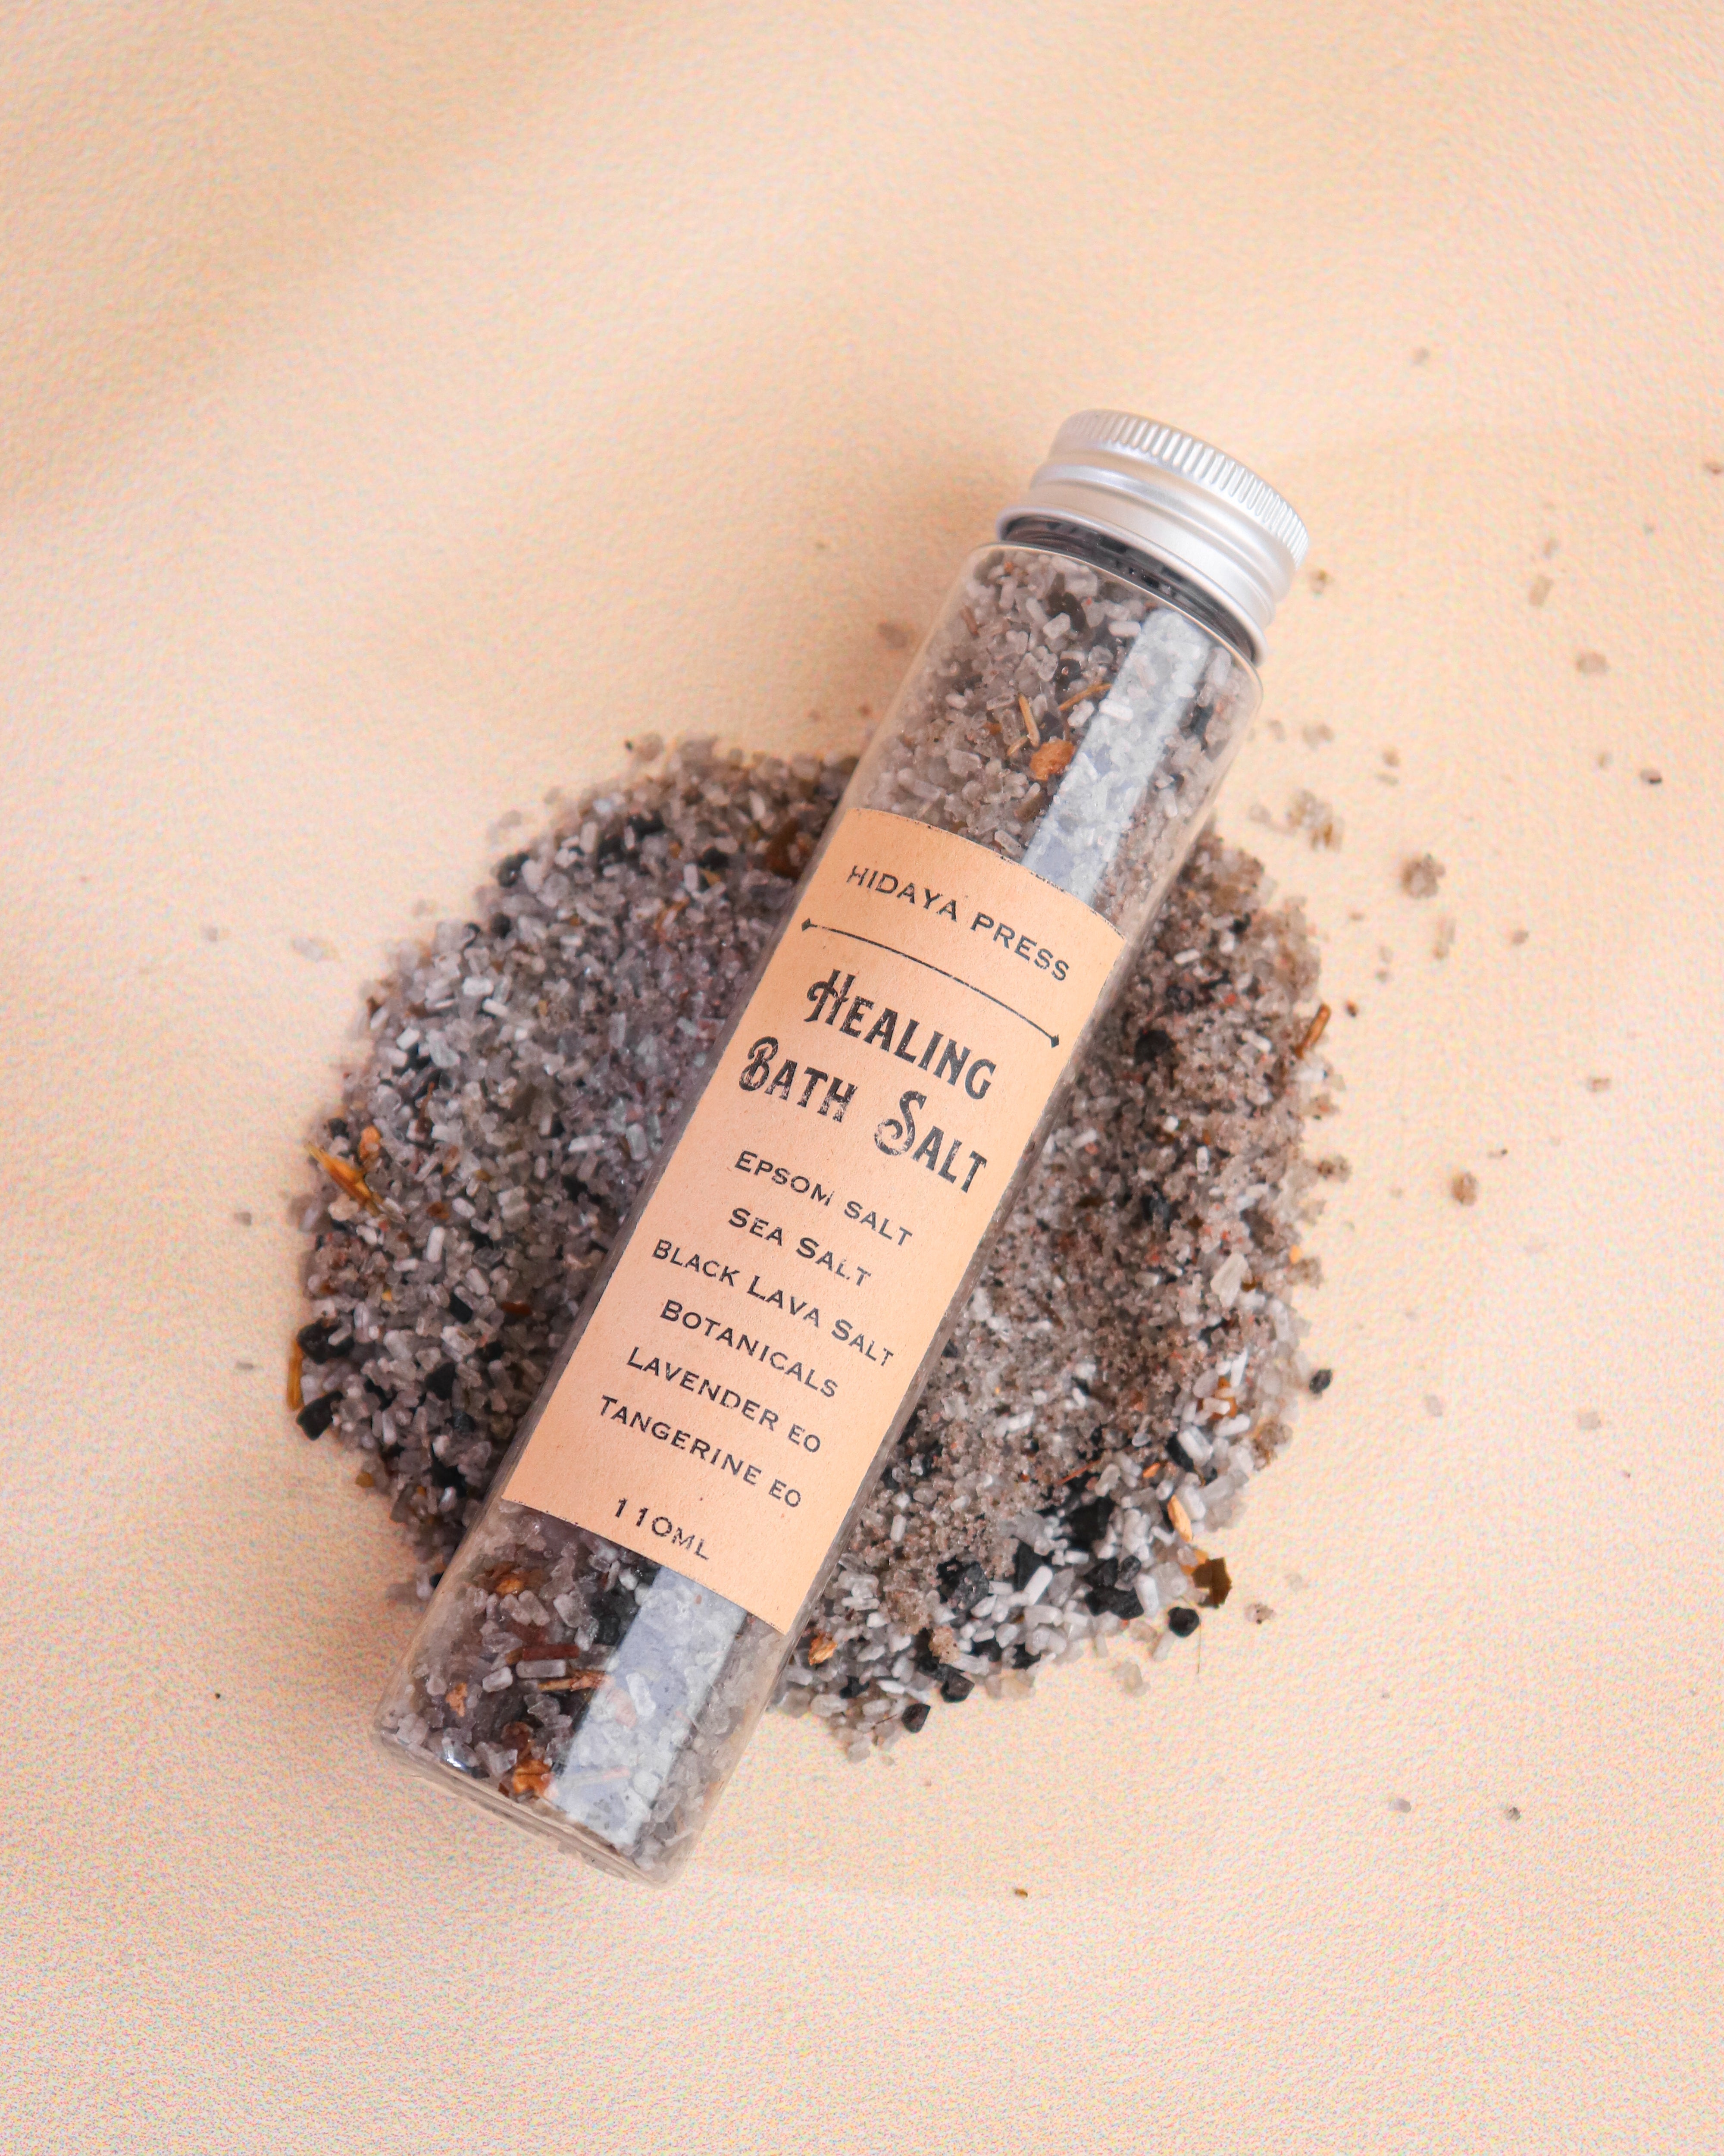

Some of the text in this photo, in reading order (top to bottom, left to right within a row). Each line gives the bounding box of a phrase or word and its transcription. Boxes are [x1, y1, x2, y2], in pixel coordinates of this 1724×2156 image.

[846, 865, 1070, 981] HIDAYA PRESS
[803, 968, 997, 1100] HEALING
[738, 1035, 988, 1194] BATH SALT
[727, 1207, 872, 1287] SEA SALT
[734, 1150, 914, 1247] EPSOM SALT
[651, 1238, 895, 1367] BLACK LAVA SALT
[659, 1298, 839, 1398] BOTANICALS
[600, 1394, 802, 1508] TANGERINE EO
[626, 1346, 821, 1453] LAVENDER EO
